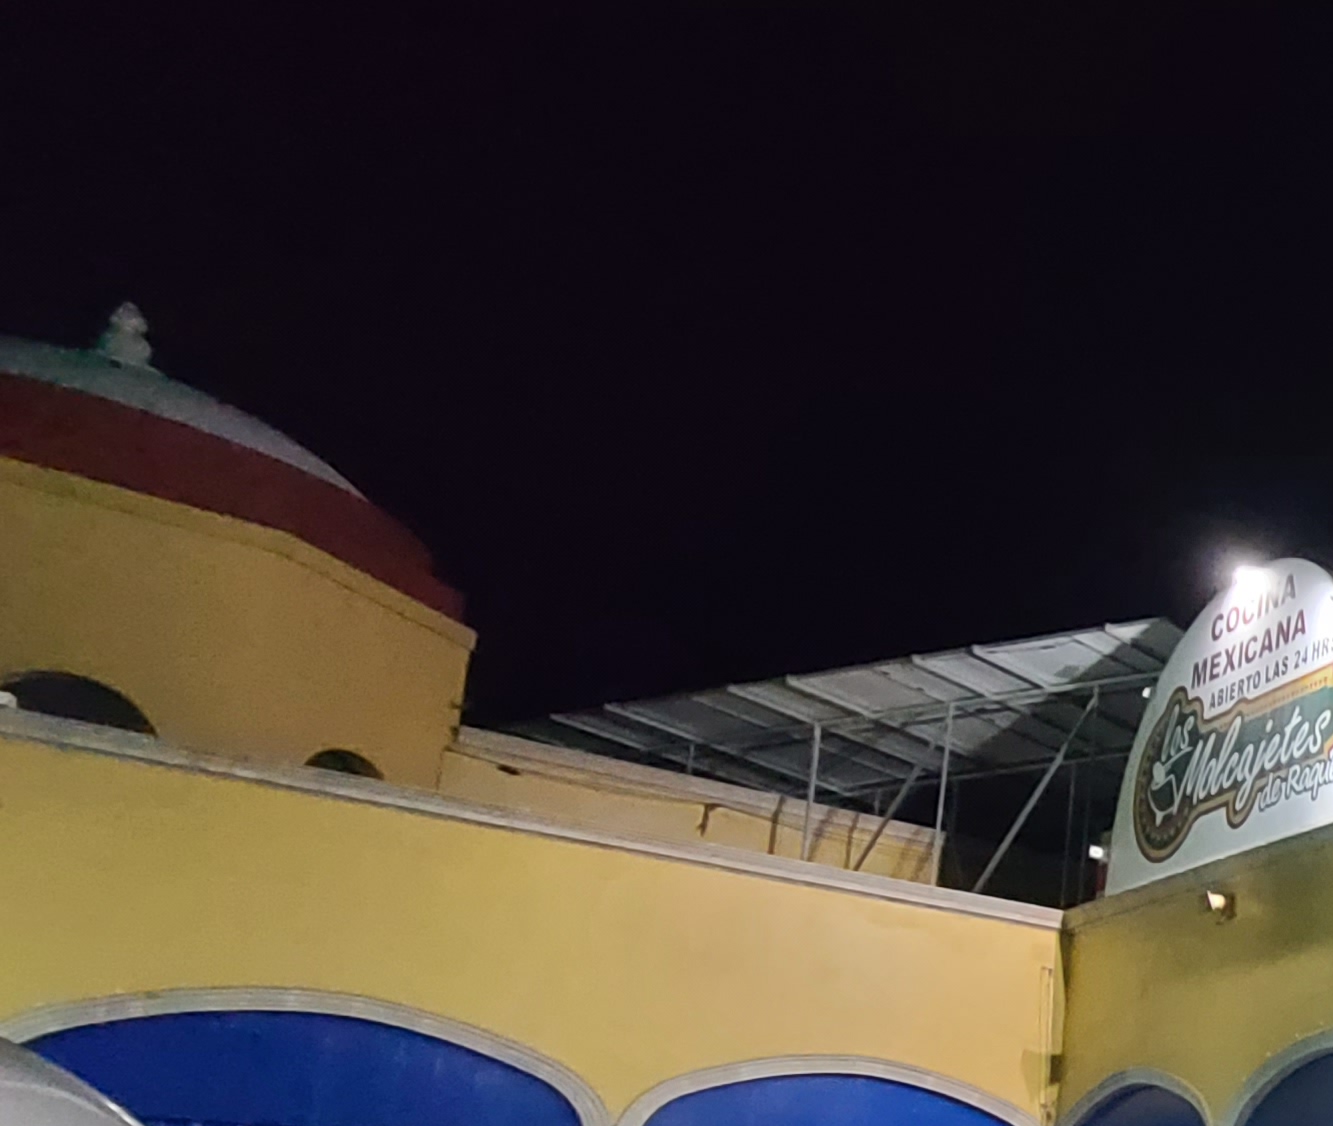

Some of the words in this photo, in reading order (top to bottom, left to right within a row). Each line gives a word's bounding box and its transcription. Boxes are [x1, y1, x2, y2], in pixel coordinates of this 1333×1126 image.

[1191, 609, 1307, 691] MEXICANA
[1208, 668, 1261, 711] ABIERTO
[1265, 656, 1289, 686] LAS
[1294, 650, 1308, 670] 24
